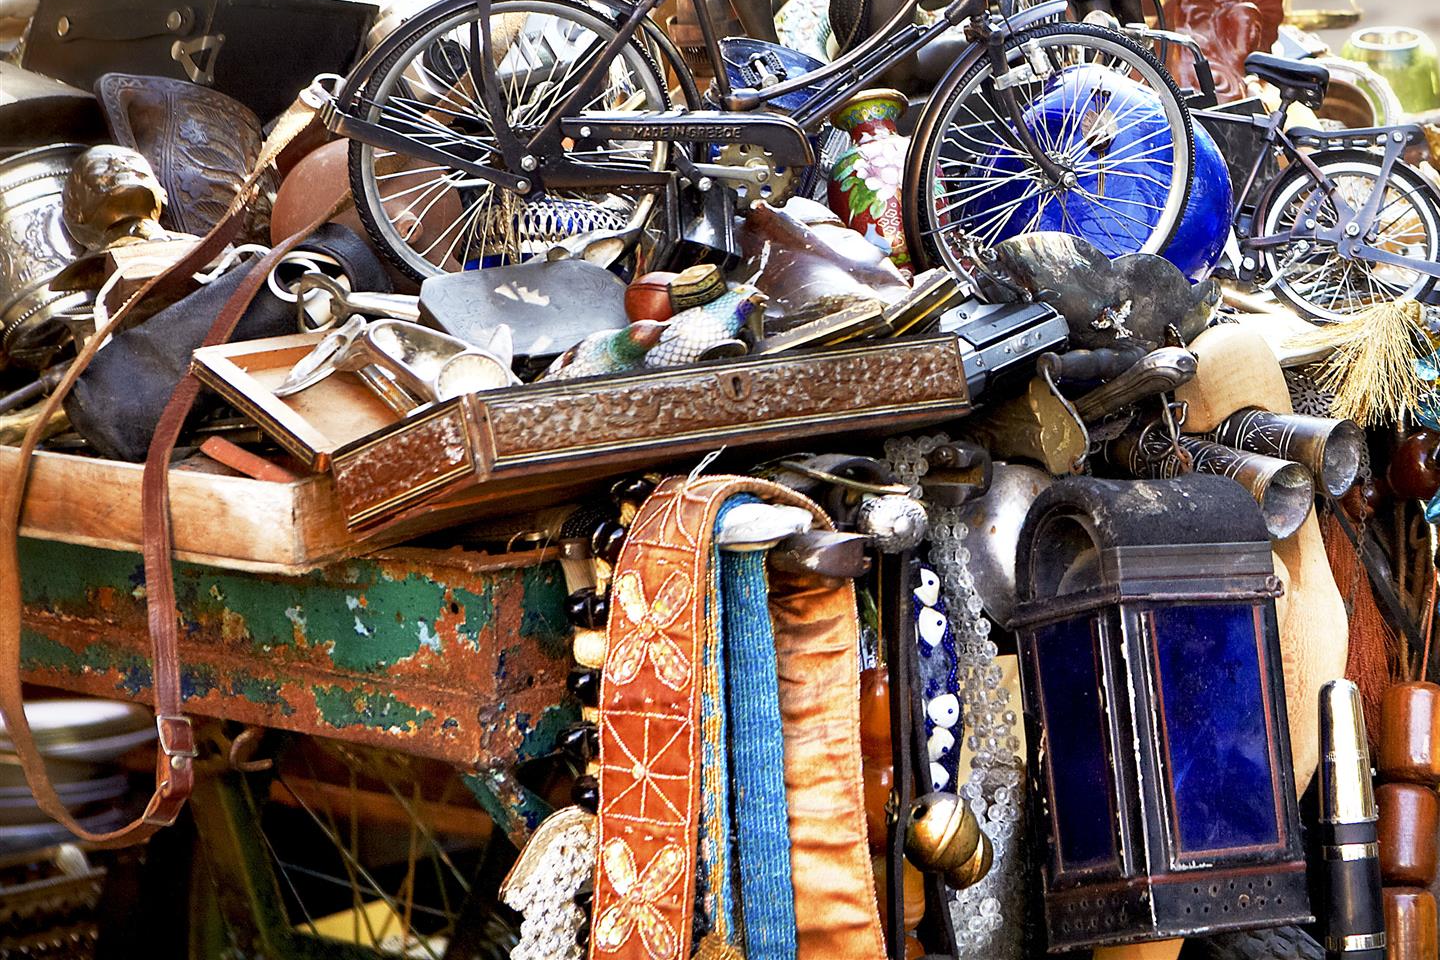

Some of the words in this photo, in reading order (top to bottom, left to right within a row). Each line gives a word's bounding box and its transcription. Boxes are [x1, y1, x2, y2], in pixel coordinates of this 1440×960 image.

[632, 126, 669, 138] MADE
[671, 126, 686, 137] IN
[687, 126, 742, 138] GREECE
